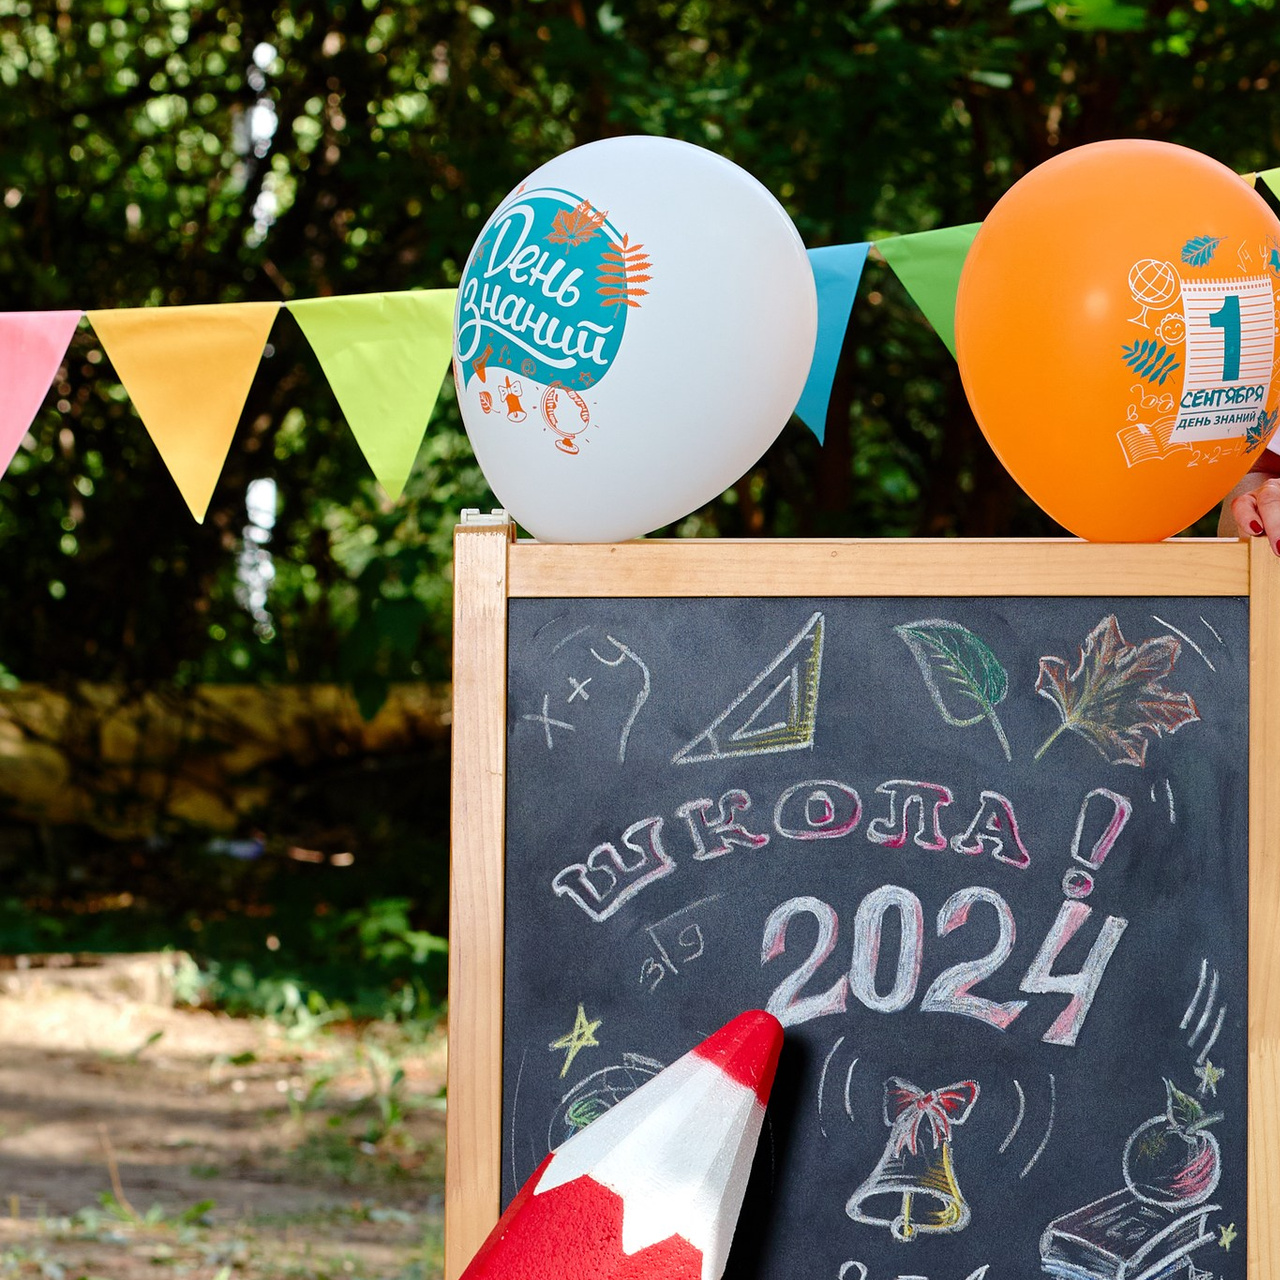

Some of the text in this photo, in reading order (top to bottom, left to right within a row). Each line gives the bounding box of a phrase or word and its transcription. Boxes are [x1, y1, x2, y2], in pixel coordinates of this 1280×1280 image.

[484, 205, 584, 307] День
[1209, 295, 1241, 381] 1
[1175, 410, 1257, 431] ДЕНЬ ЗНАНИЙ
[1180, 384, 1265, 409] СЕНТЯБРЯ
[551, 779, 1132, 922] ШКОЛА!
[760, 880, 1129, 1048] 2024
